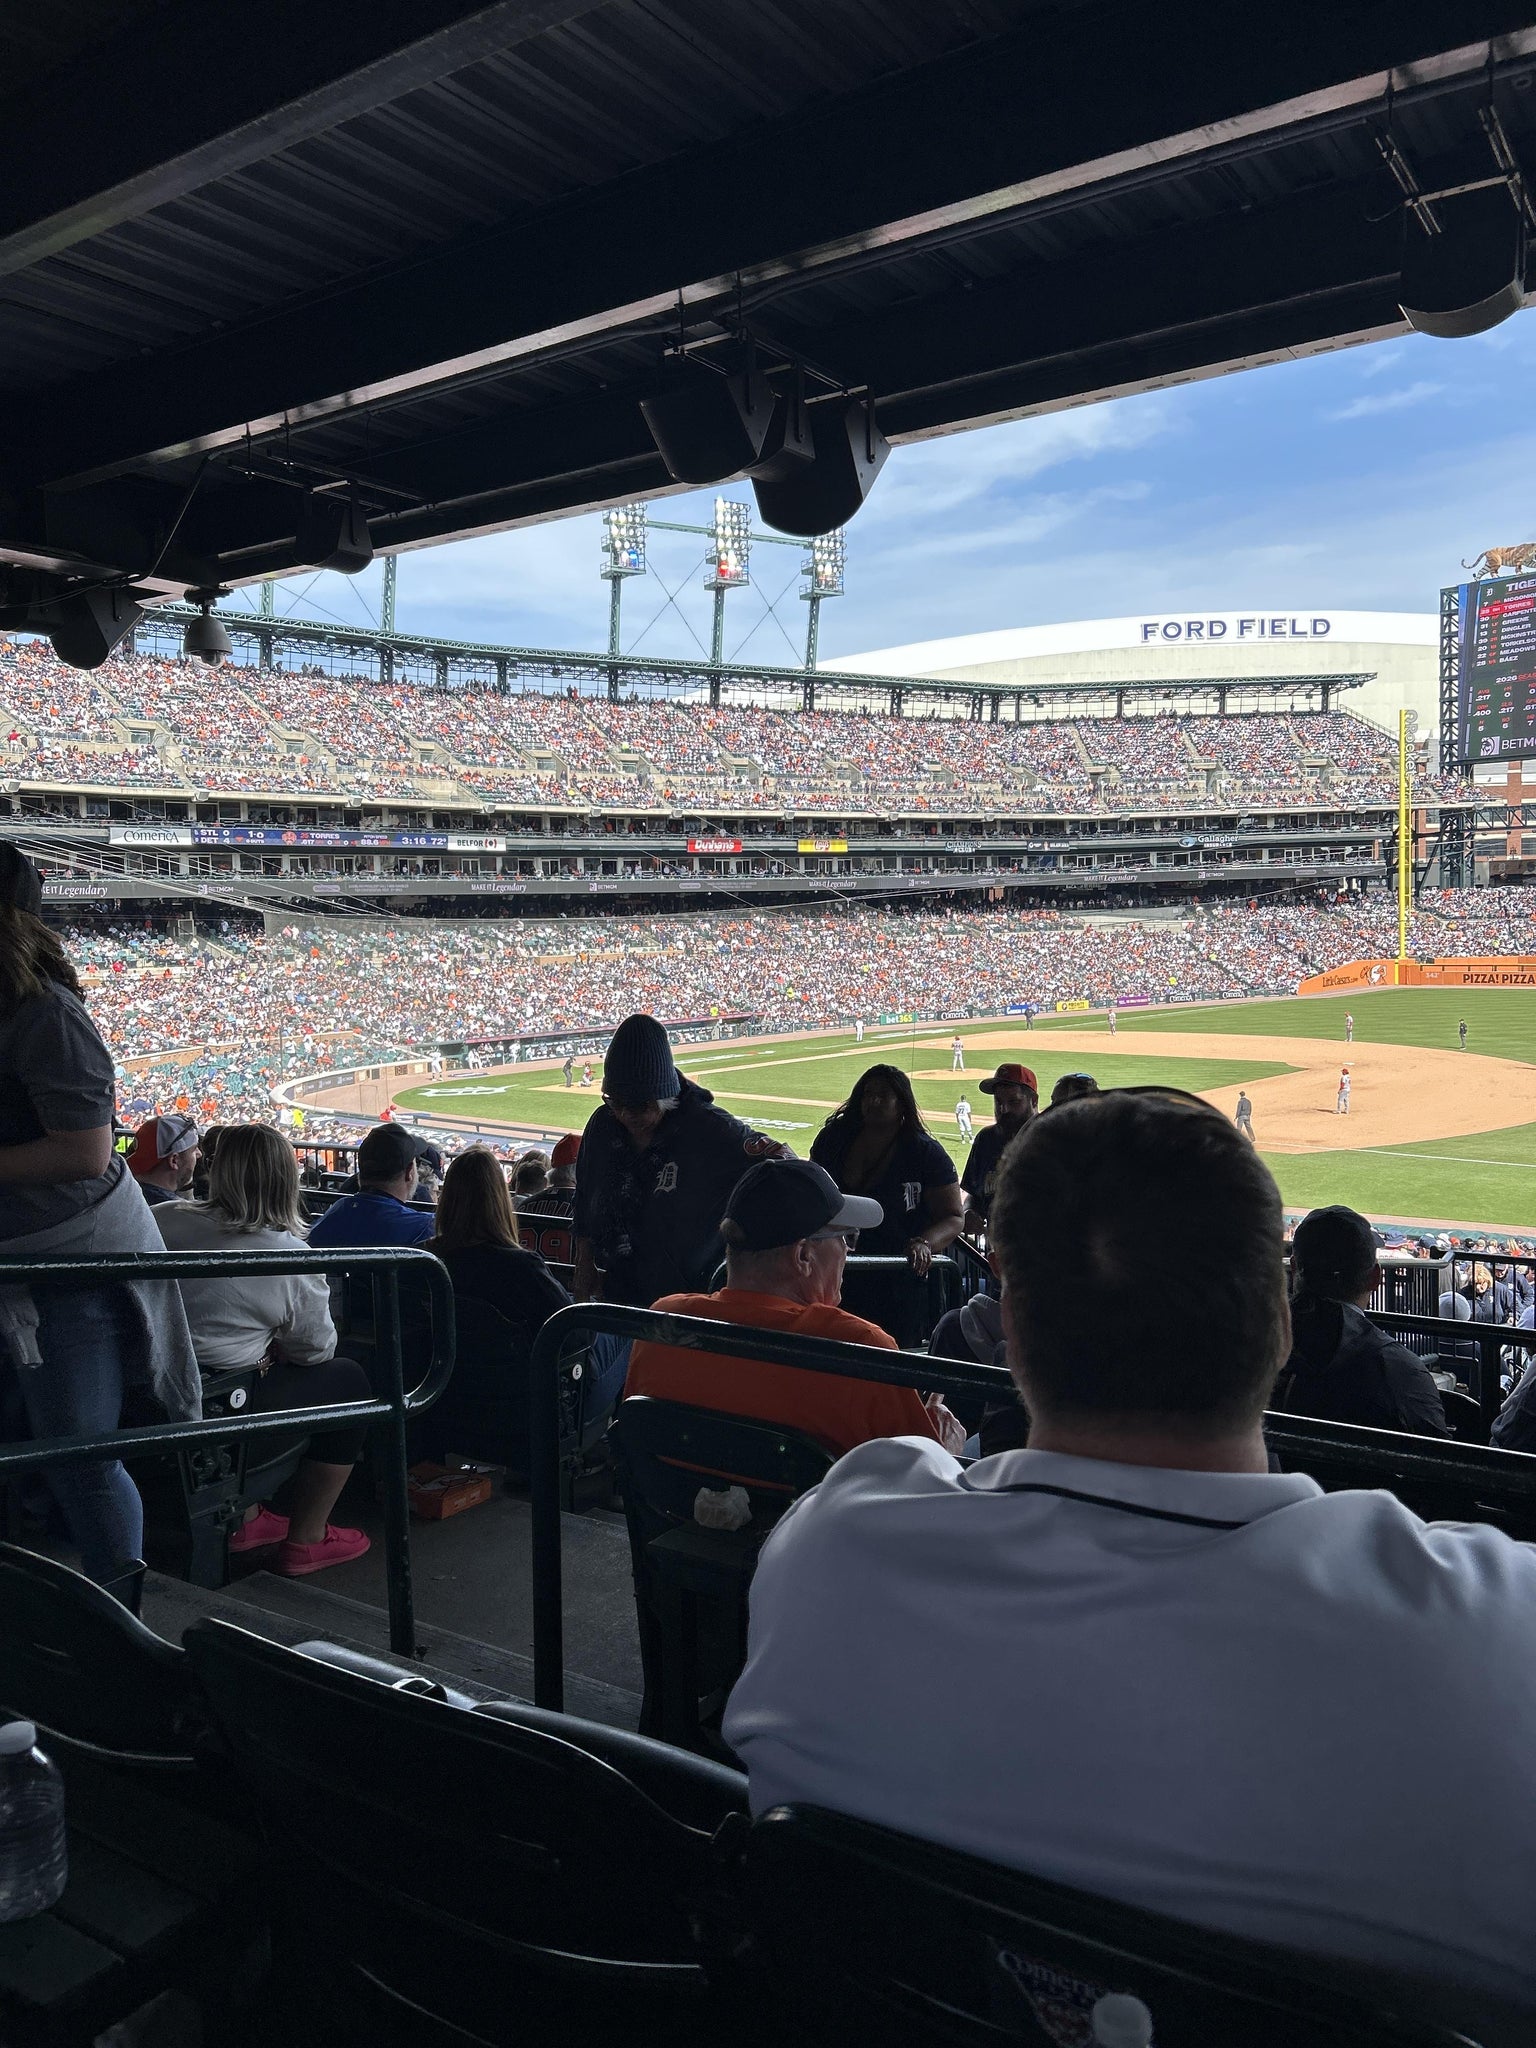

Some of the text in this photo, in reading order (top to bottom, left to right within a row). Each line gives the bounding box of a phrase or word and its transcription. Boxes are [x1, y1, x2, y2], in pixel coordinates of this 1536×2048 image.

[1504, 601, 1532, 610] TORRES
[1502, 616, 1530, 626] GREENE
[1141, 618, 1331, 643] FORD FIELD
[1502, 624, 1532, 633] DINGLER
[1500, 645, 1536, 655] MEADOWS
[1501, 737, 1536, 750] BETM
[1406, 724, 1418, 776] Rocket
[402, 837, 427, 845] 3:16
[1198, 834, 1239, 844] Gallagher
[695, 840, 734, 850] Dunham's
[1104, 874, 1138, 882] Legendary
[492, 883, 527, 893] Legendary
[827, 880, 857, 889] Legendary
[59, 885, 108, 897] Legendary
[1463, 974, 1536, 984] PIZZA! PIZZA
[886, 1014, 912, 1024] bet365
